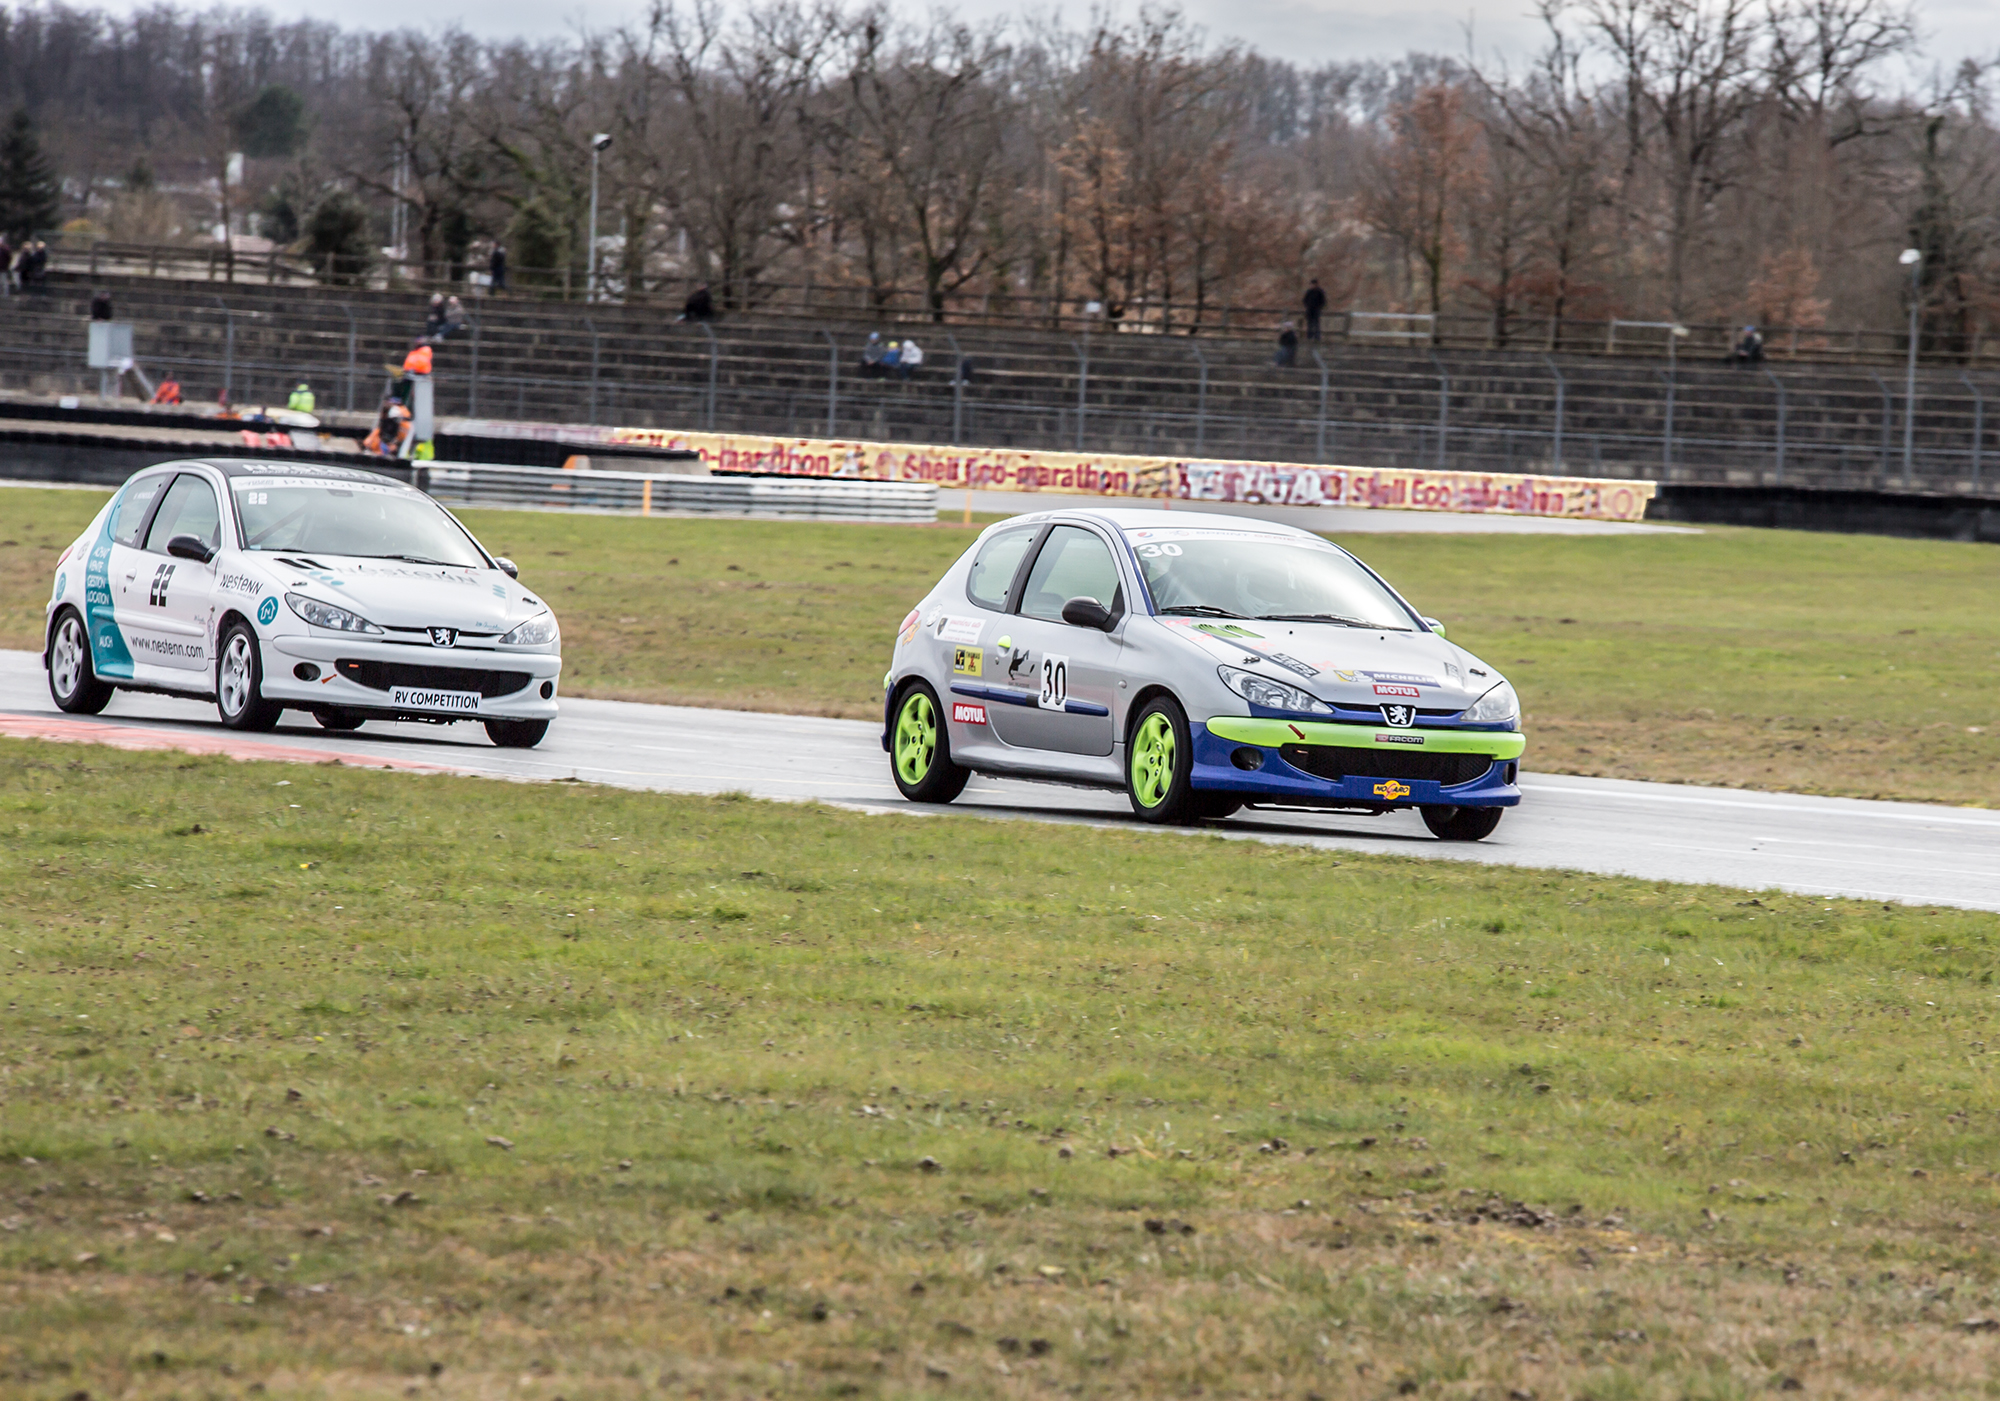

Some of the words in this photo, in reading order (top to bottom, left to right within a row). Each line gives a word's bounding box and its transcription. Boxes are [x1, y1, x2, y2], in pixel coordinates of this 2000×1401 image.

[248, 492, 268, 505] 22
[1139, 543, 1183, 558] 30
[149, 563, 176, 607] 22
[87, 591, 110, 605] LOCATION
[130, 635, 205, 659] www.nestenn.com
[1042, 658, 1067, 706] 30
[1373, 672, 1437, 684] MICHELIN
[1376, 685, 1419, 696] MOTUL
[394, 690, 408, 704] RV
[410, 691, 479, 709] COMPETITION
[954, 705, 986, 723] MOTUL
